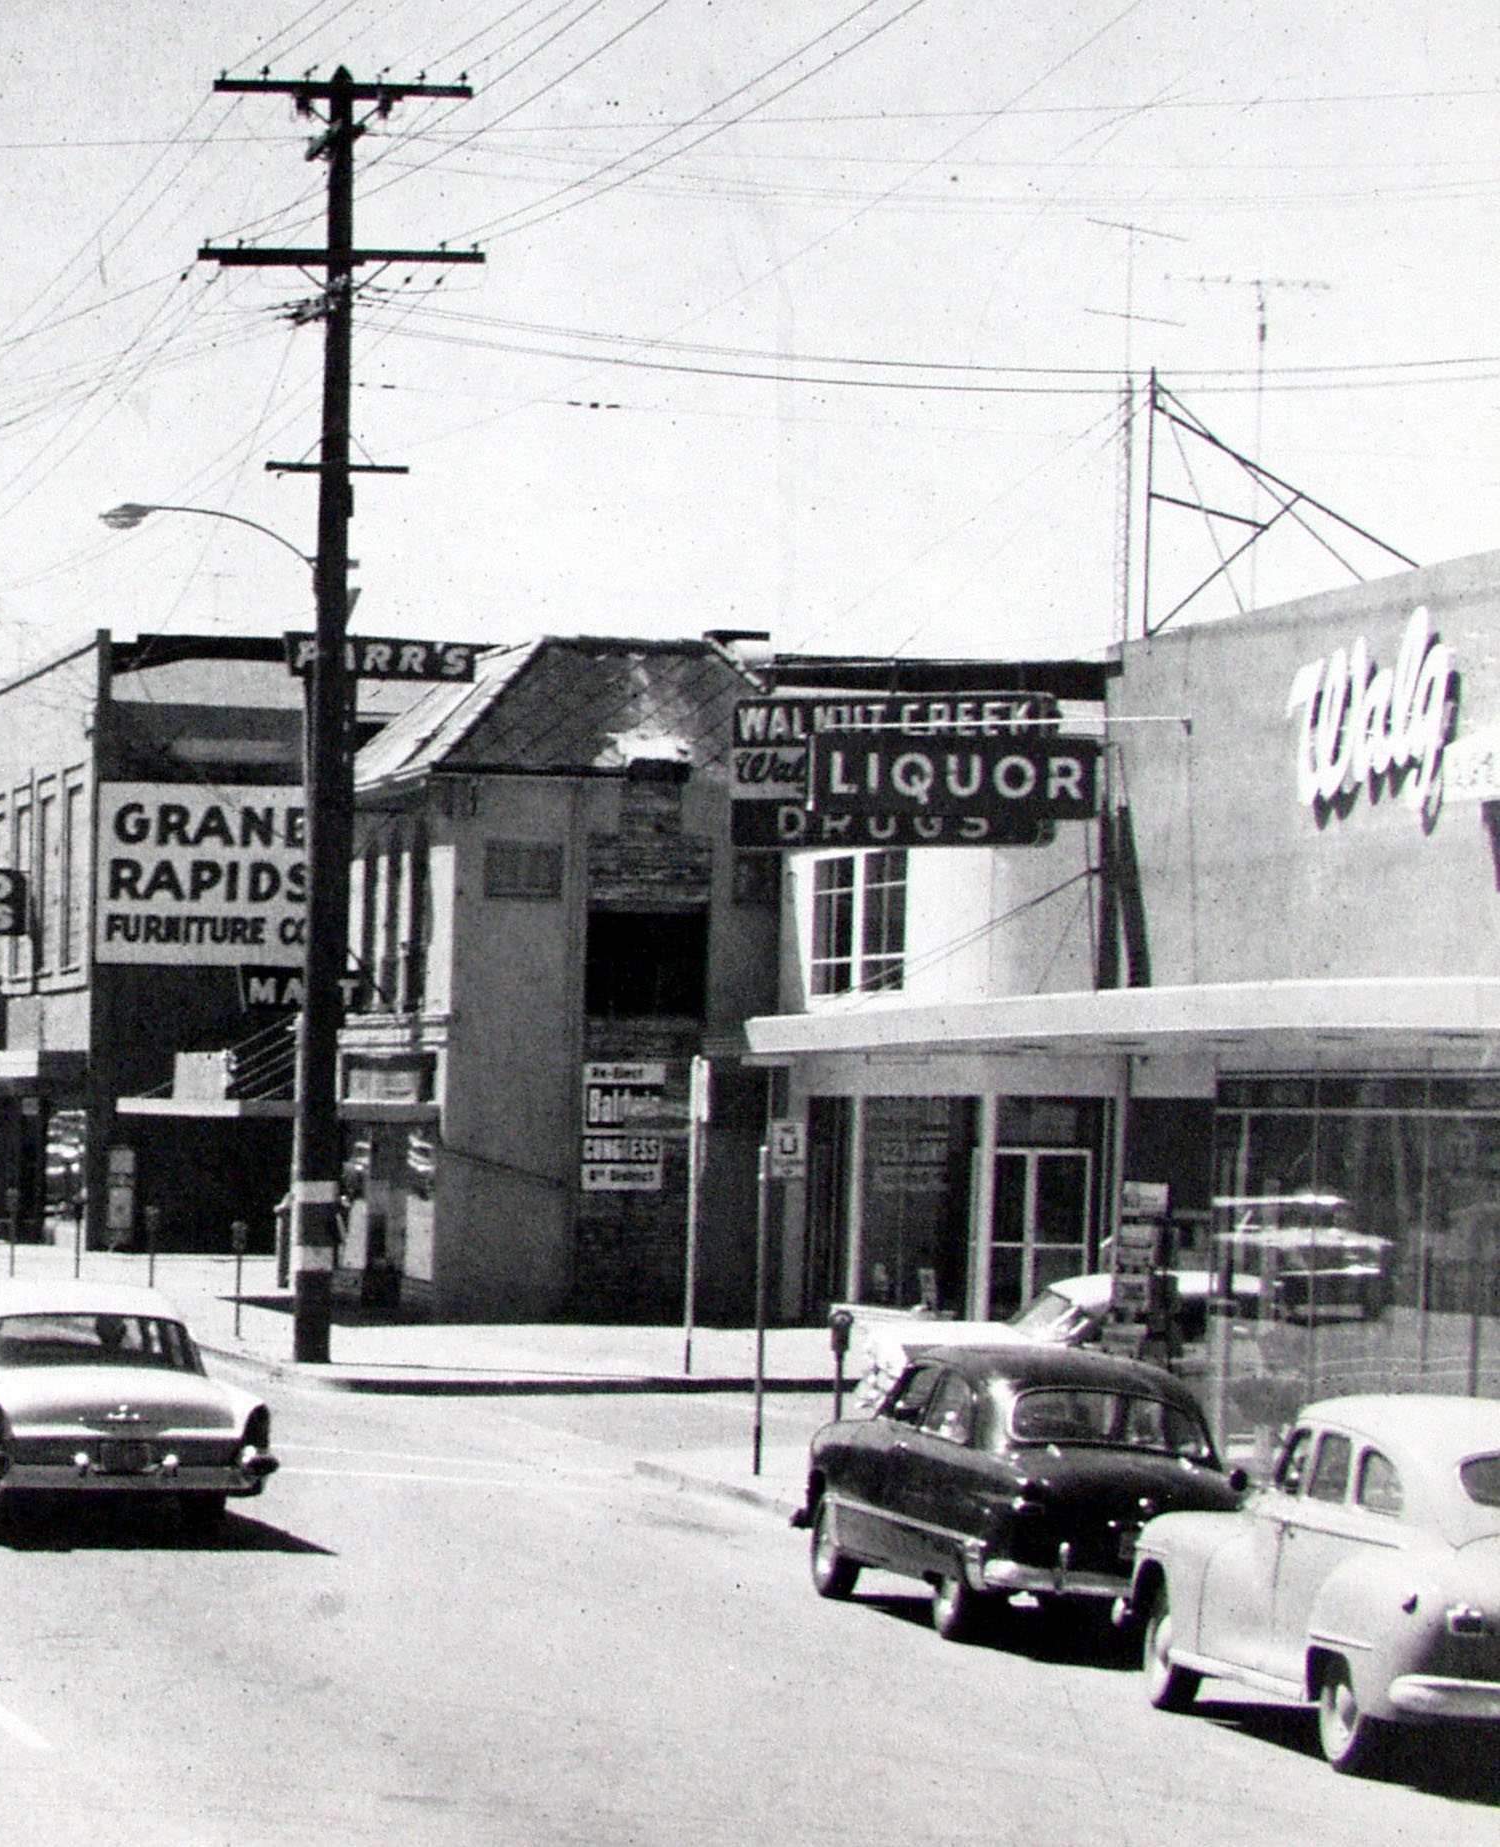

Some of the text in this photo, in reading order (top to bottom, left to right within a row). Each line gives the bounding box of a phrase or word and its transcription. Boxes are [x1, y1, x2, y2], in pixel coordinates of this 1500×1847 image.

[738, 703, 1032, 741] WALNUT CREEK
[829, 750, 1084, 805] LIQUOR
[776, 805, 991, 840] DRUGS
[108, 857, 307, 904] RAPIDS
[105, 913, 267, 945] FURNITURE
[249, 976, 360, 1005] MAT
